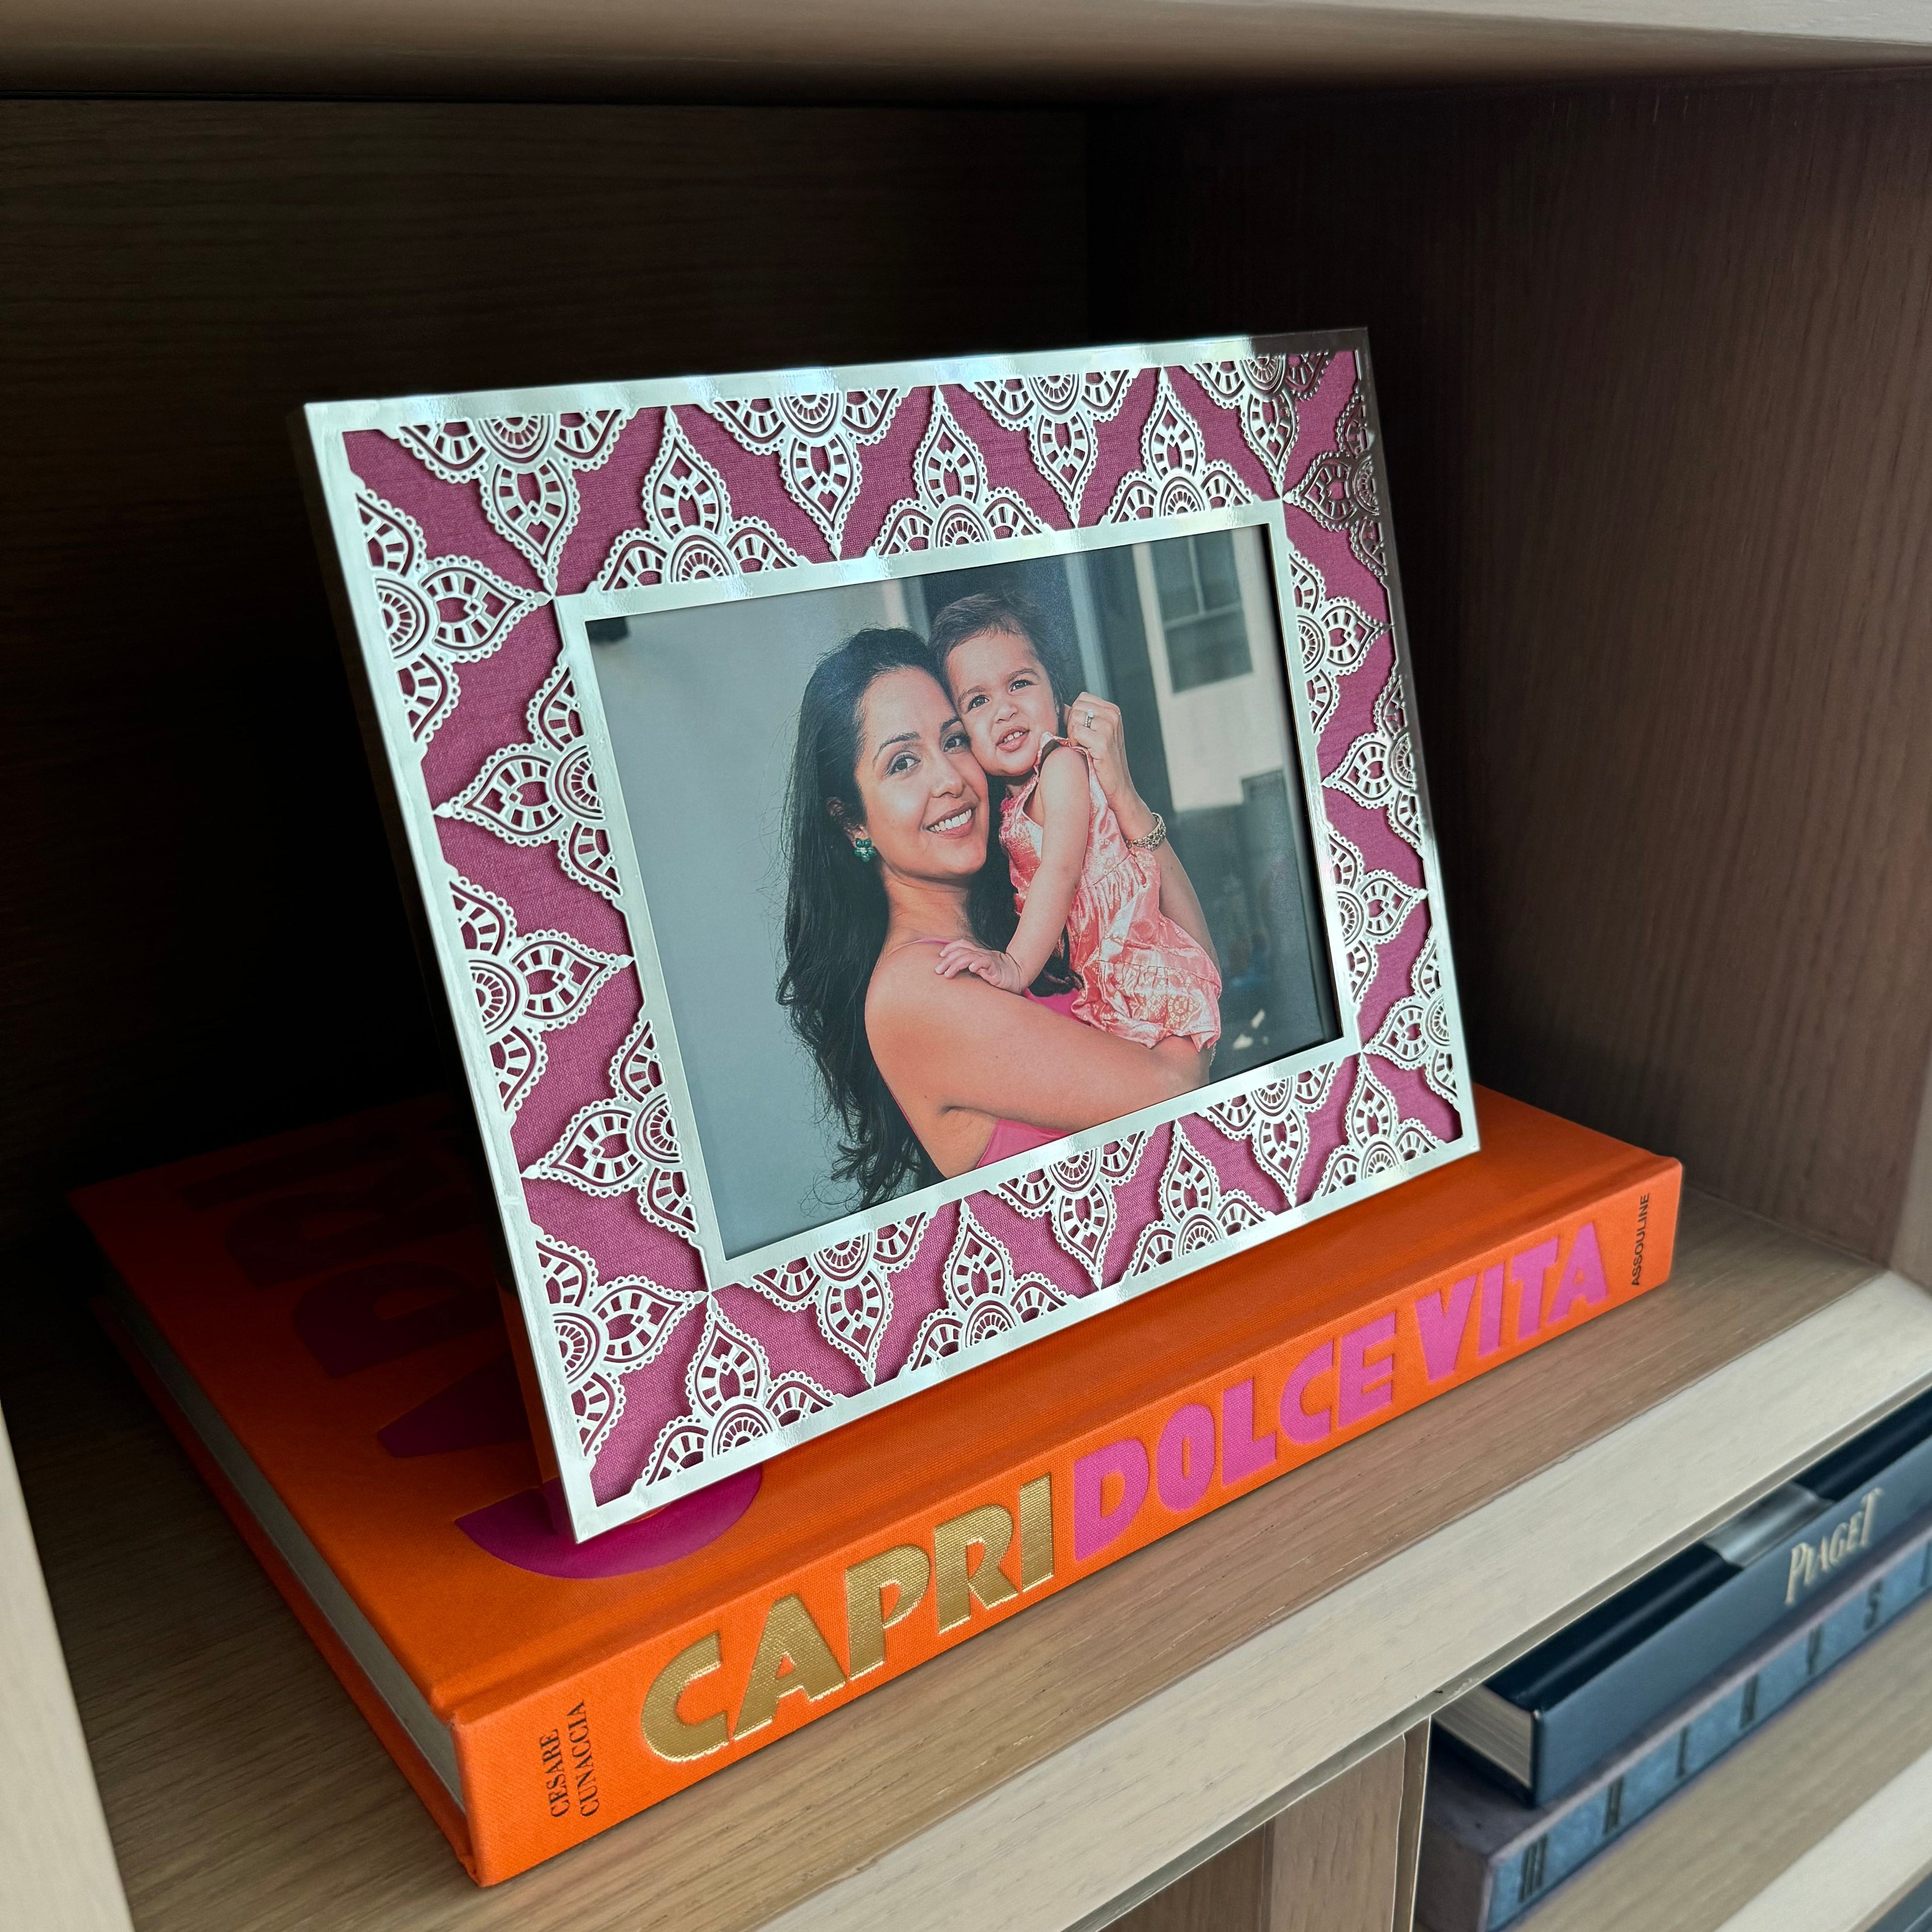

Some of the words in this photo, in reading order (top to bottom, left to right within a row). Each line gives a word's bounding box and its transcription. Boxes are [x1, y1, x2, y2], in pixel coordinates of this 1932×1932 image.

[1631, 1192, 1650, 1286] ASSOULINE
[641, 1473, 1055, 1763] CAPRI
[1073, 1312, 1397, 1563] DOLCE
[1414, 1222, 1607, 1384] VITA
[1786, 1487, 1883, 1606] PIAGET
[539, 1728, 570, 1818] CESARE
[567, 1699, 600, 1817] CUNACCIA
